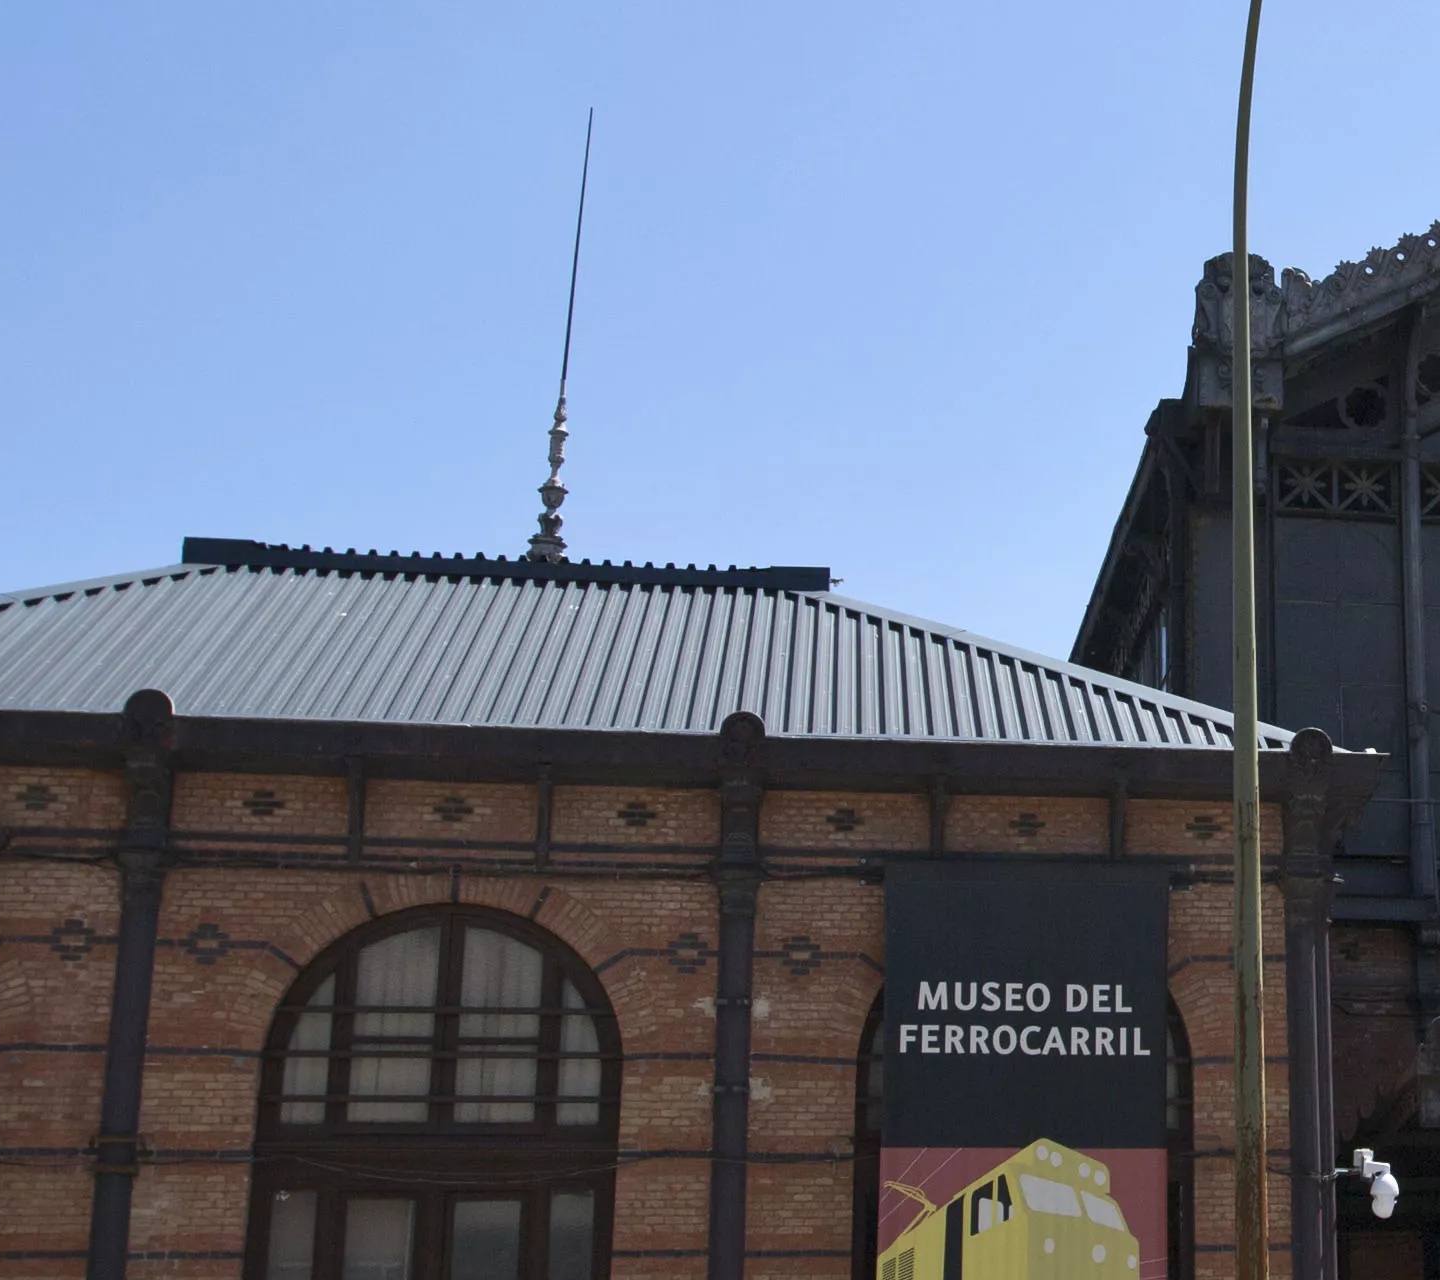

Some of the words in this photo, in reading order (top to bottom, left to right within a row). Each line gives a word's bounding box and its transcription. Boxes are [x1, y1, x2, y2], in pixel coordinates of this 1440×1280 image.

[917, 981, 1051, 1012] MUSEO
[1066, 984, 1133, 1013] DEL
[899, 1024, 1151, 1056] FERROCARRIL
